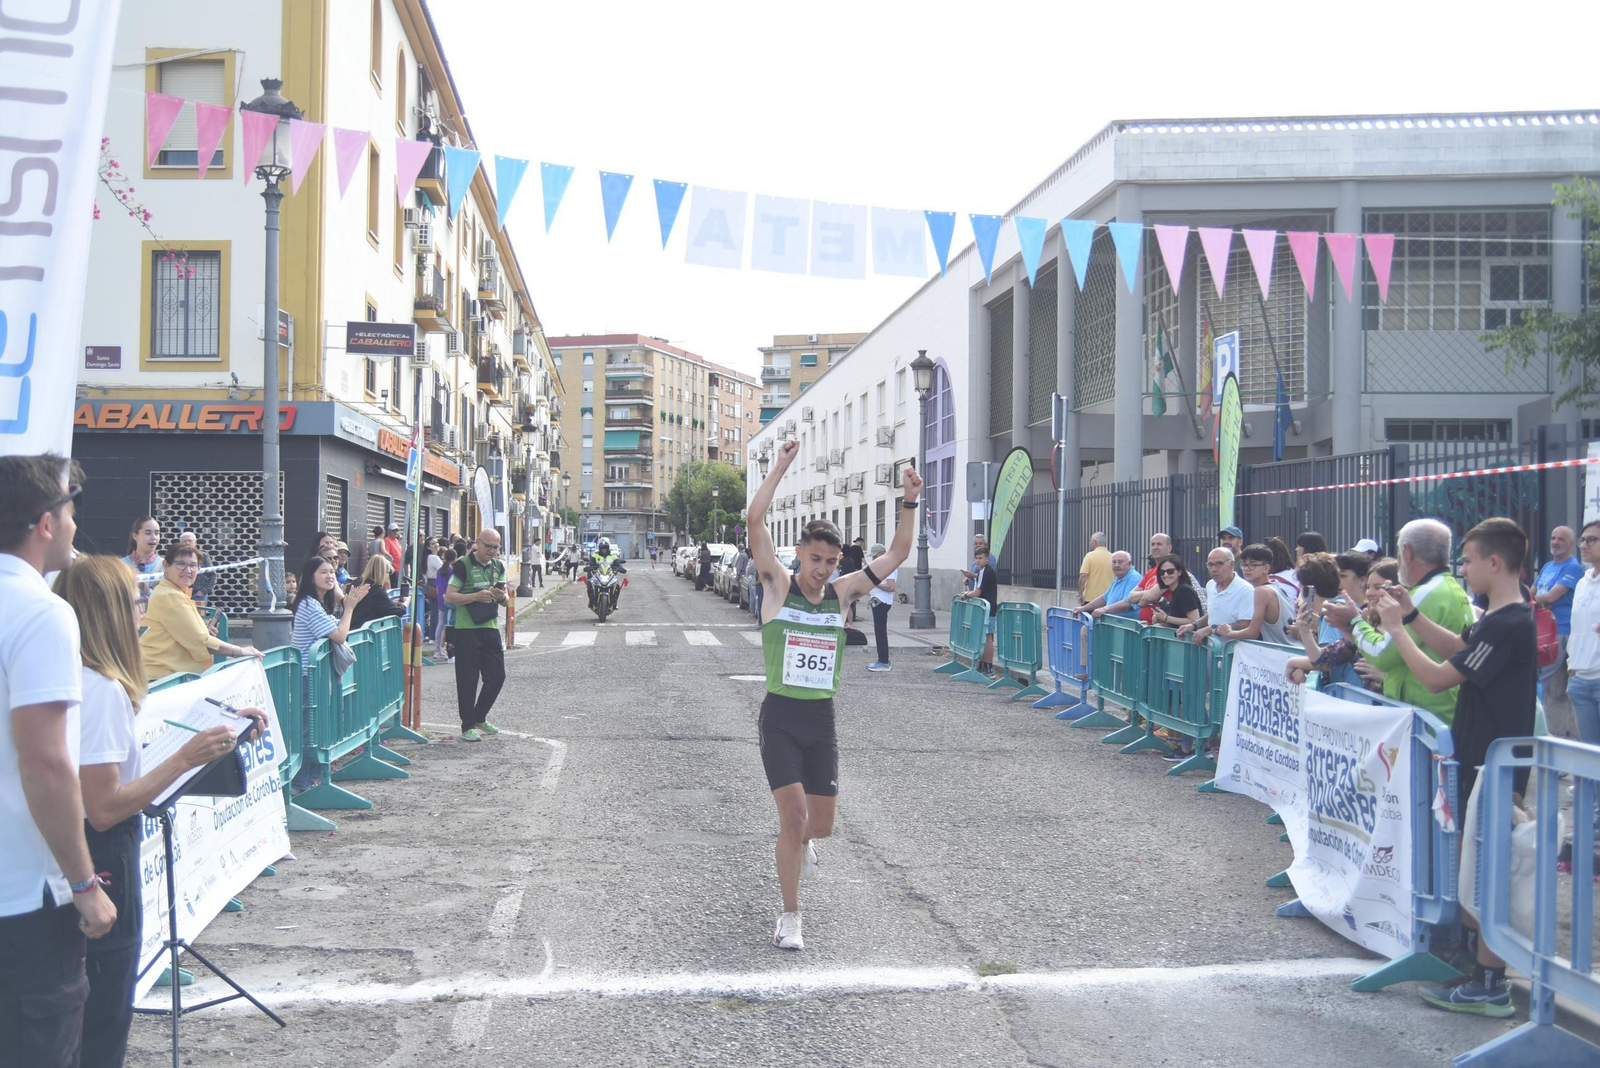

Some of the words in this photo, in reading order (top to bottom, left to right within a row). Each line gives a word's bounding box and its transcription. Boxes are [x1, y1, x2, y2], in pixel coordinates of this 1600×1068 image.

[349, 338, 412, 348] CABALLERO
[86, 361, 107, 369] Domingo
[73, 403, 297, 431] ABALLERO
[795, 652, 828, 672] 365
[1238, 676, 1290, 717] carreras
[1237, 698, 1300, 745] populares
[1236, 732, 1264, 758] Diputación
[1265, 745, 1274, 761] de
[1274, 748, 1300, 772] Córdoba
[1305, 740, 1357, 796] arreras
[1306, 771, 1378, 835] opulares
